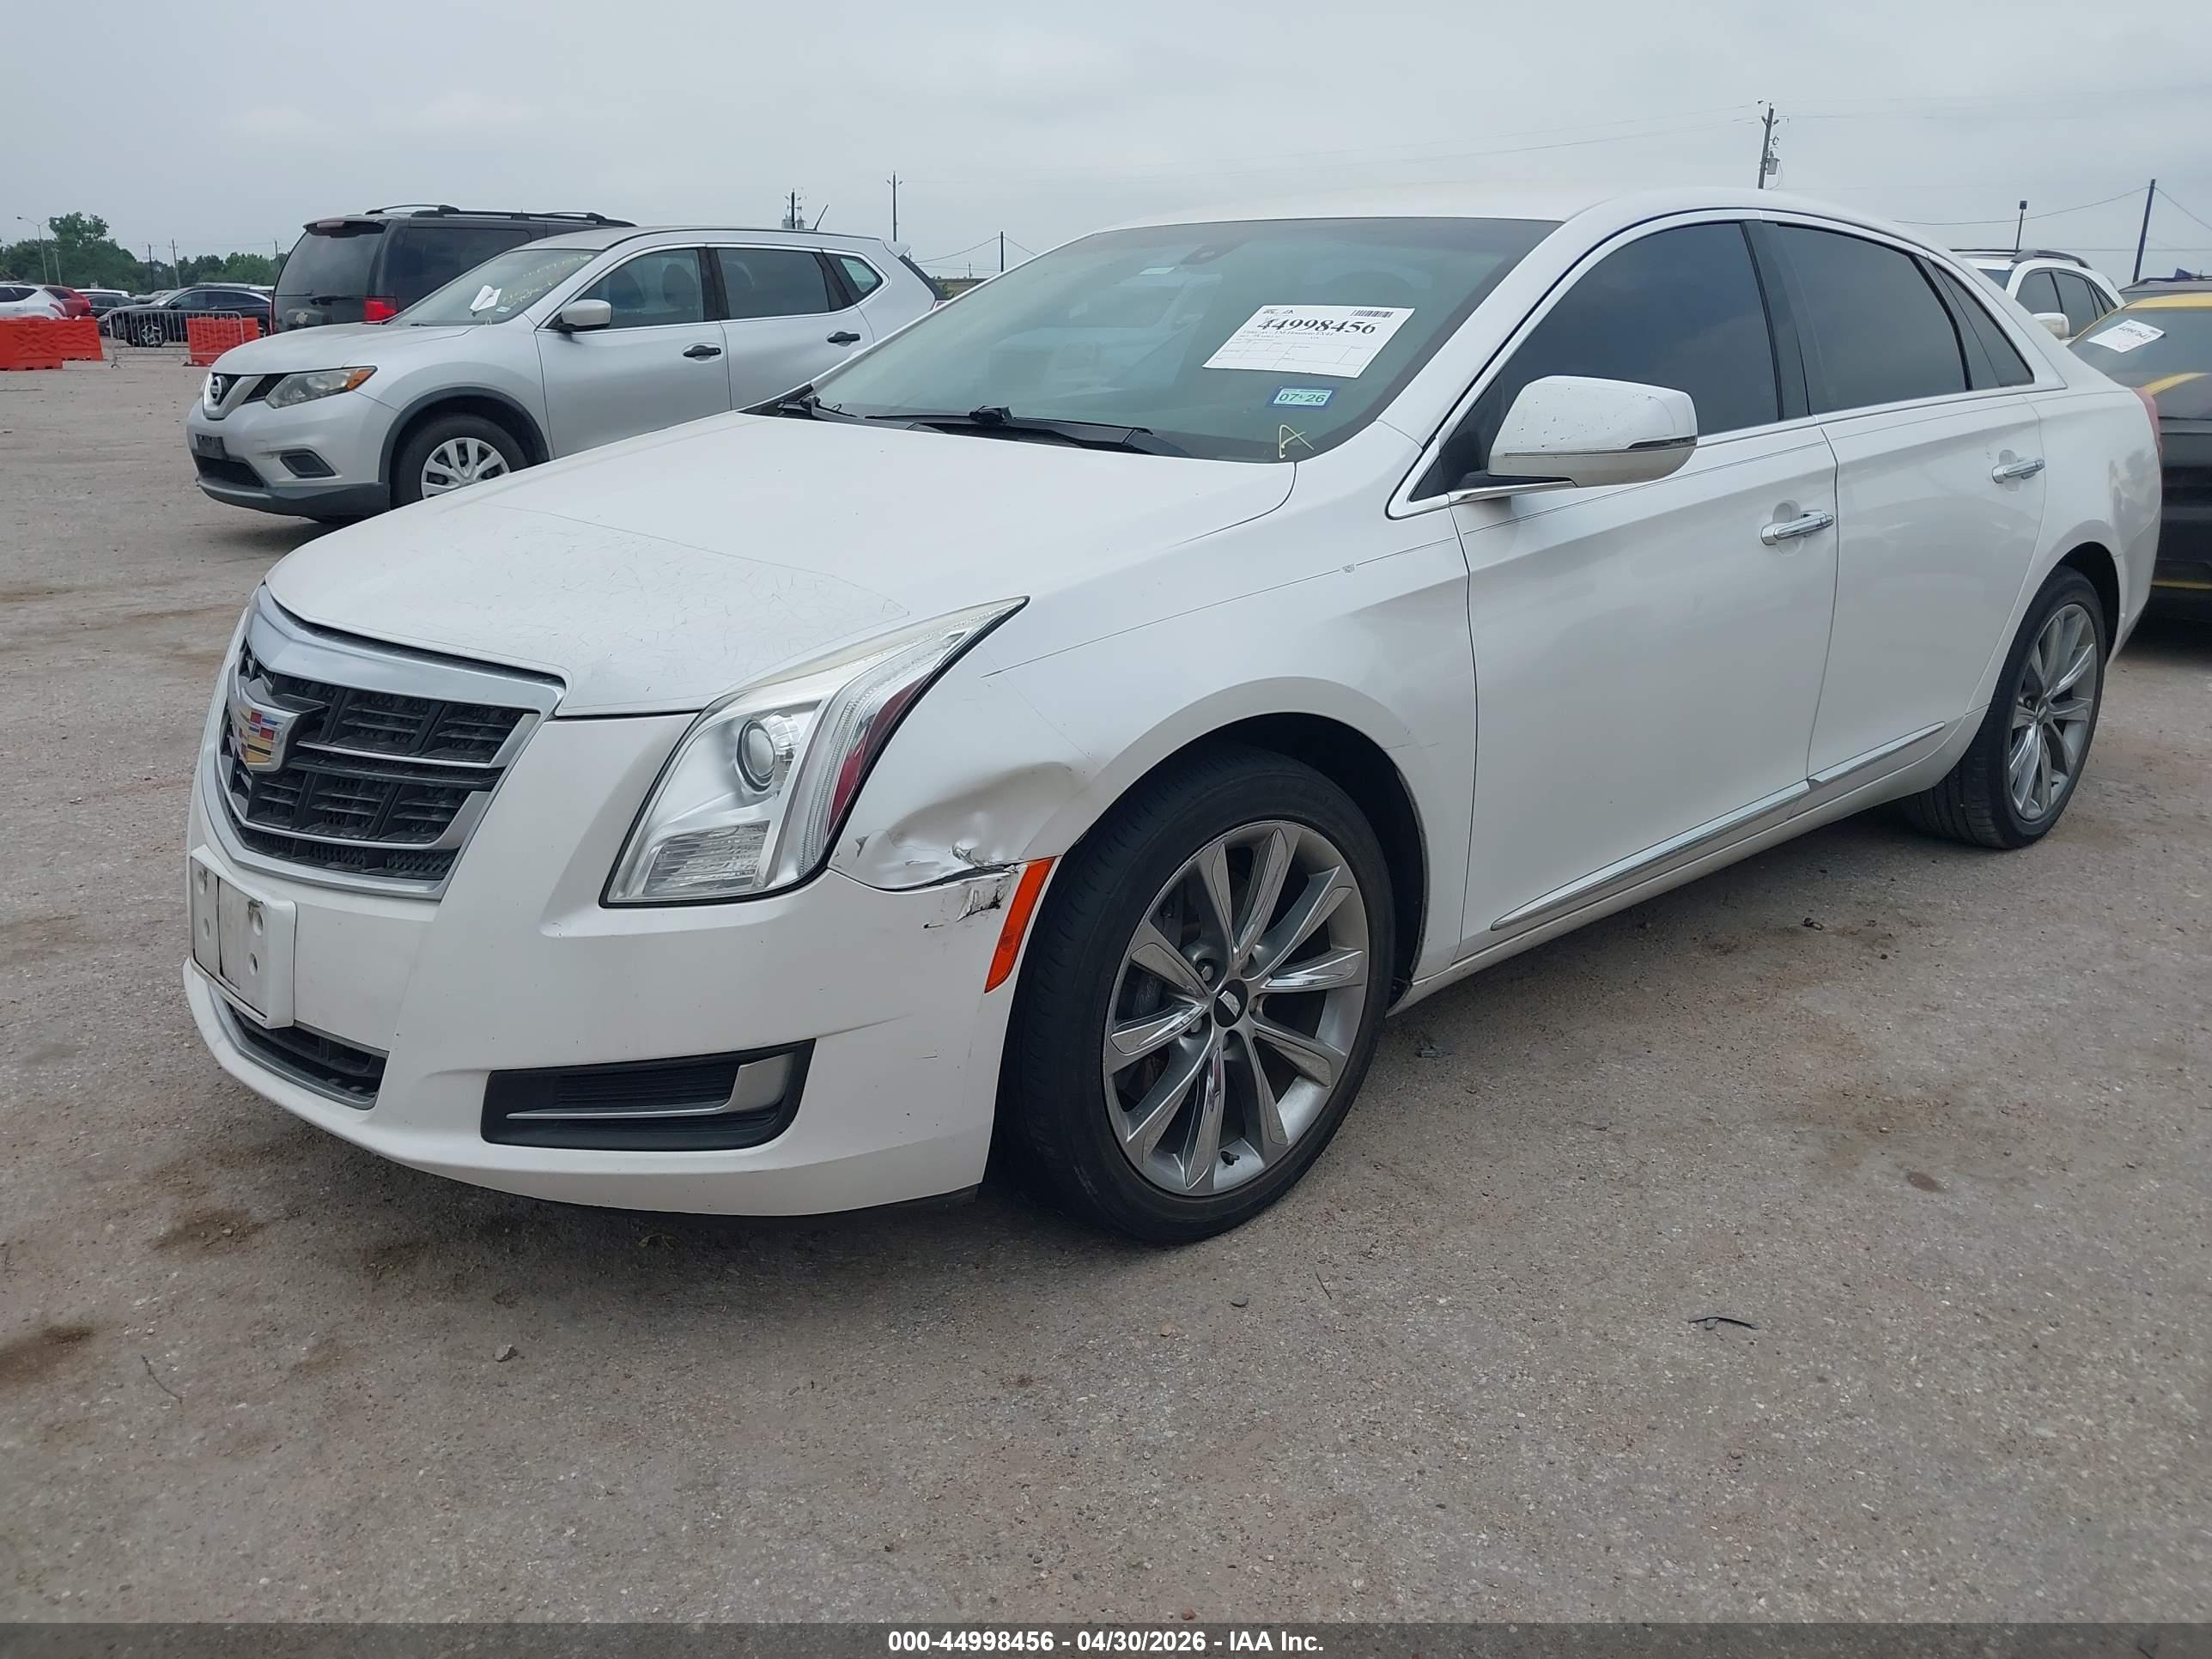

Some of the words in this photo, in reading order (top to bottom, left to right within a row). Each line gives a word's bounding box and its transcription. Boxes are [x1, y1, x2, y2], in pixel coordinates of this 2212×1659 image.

[1257, 319, 1382, 335] 44998456
[1279, 393, 1299, 402] 07
[1304, 394, 1327, 403] 26
